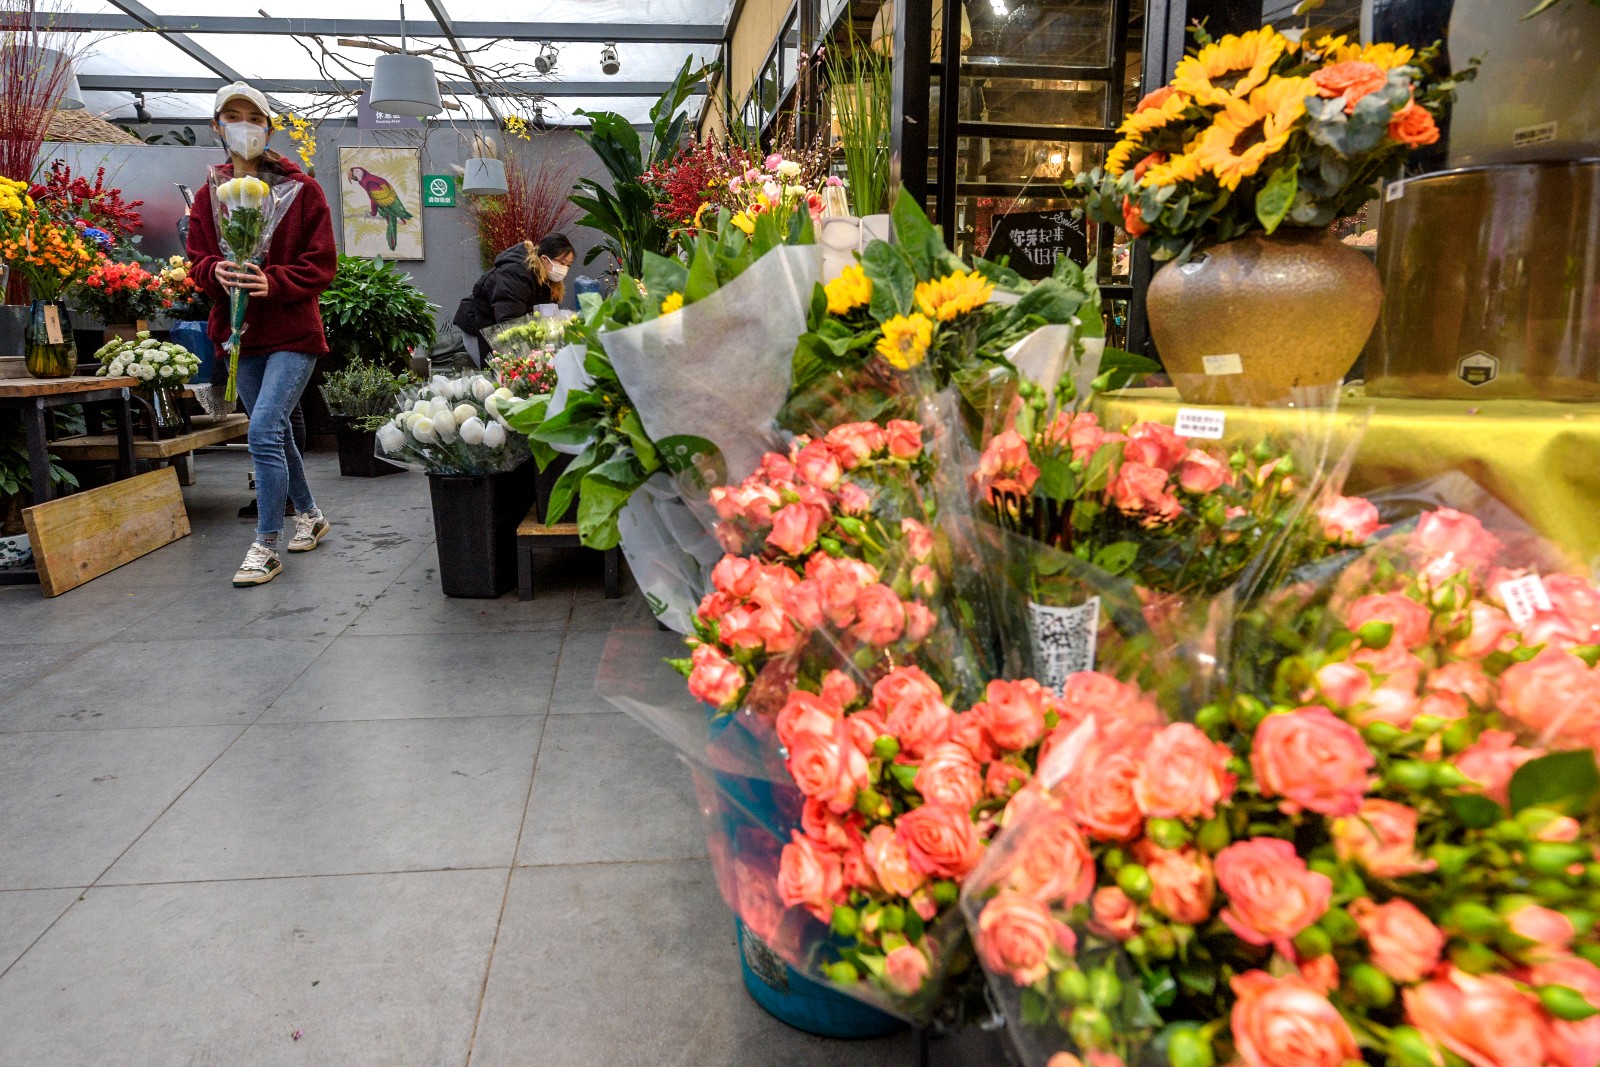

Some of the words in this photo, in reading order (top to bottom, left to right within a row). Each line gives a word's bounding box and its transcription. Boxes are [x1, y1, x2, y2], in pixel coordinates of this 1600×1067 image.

[1053, 211, 1081, 231] Smile
[1009, 226, 1064, 248] 你笑起来
